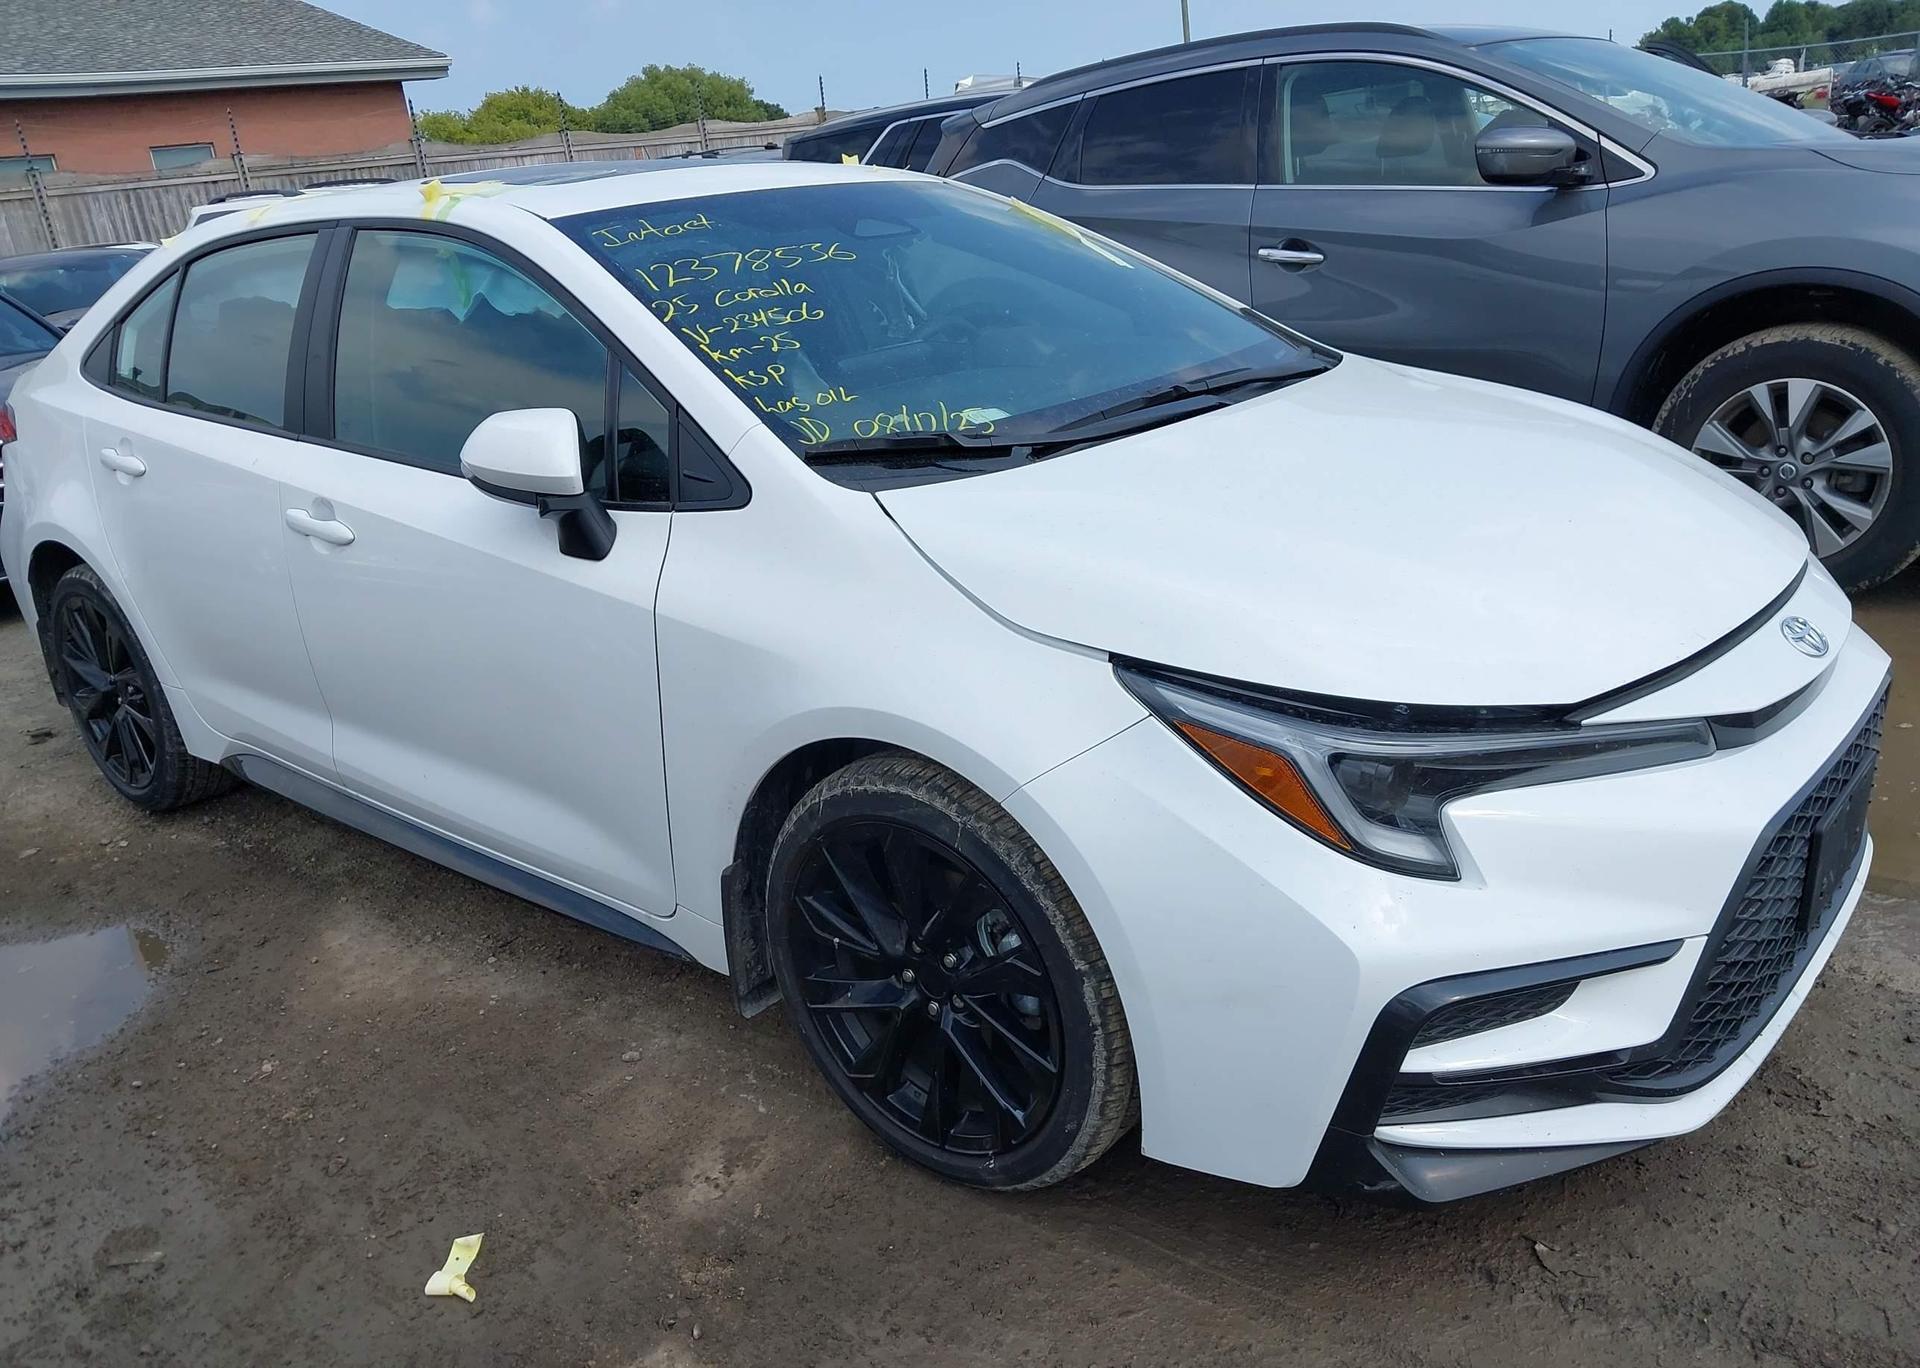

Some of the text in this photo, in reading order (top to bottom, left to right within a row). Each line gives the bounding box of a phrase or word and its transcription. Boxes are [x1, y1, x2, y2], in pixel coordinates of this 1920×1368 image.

[635, 243, 857, 291] 12378536
[651, 279, 815, 323] 25 Corolla
